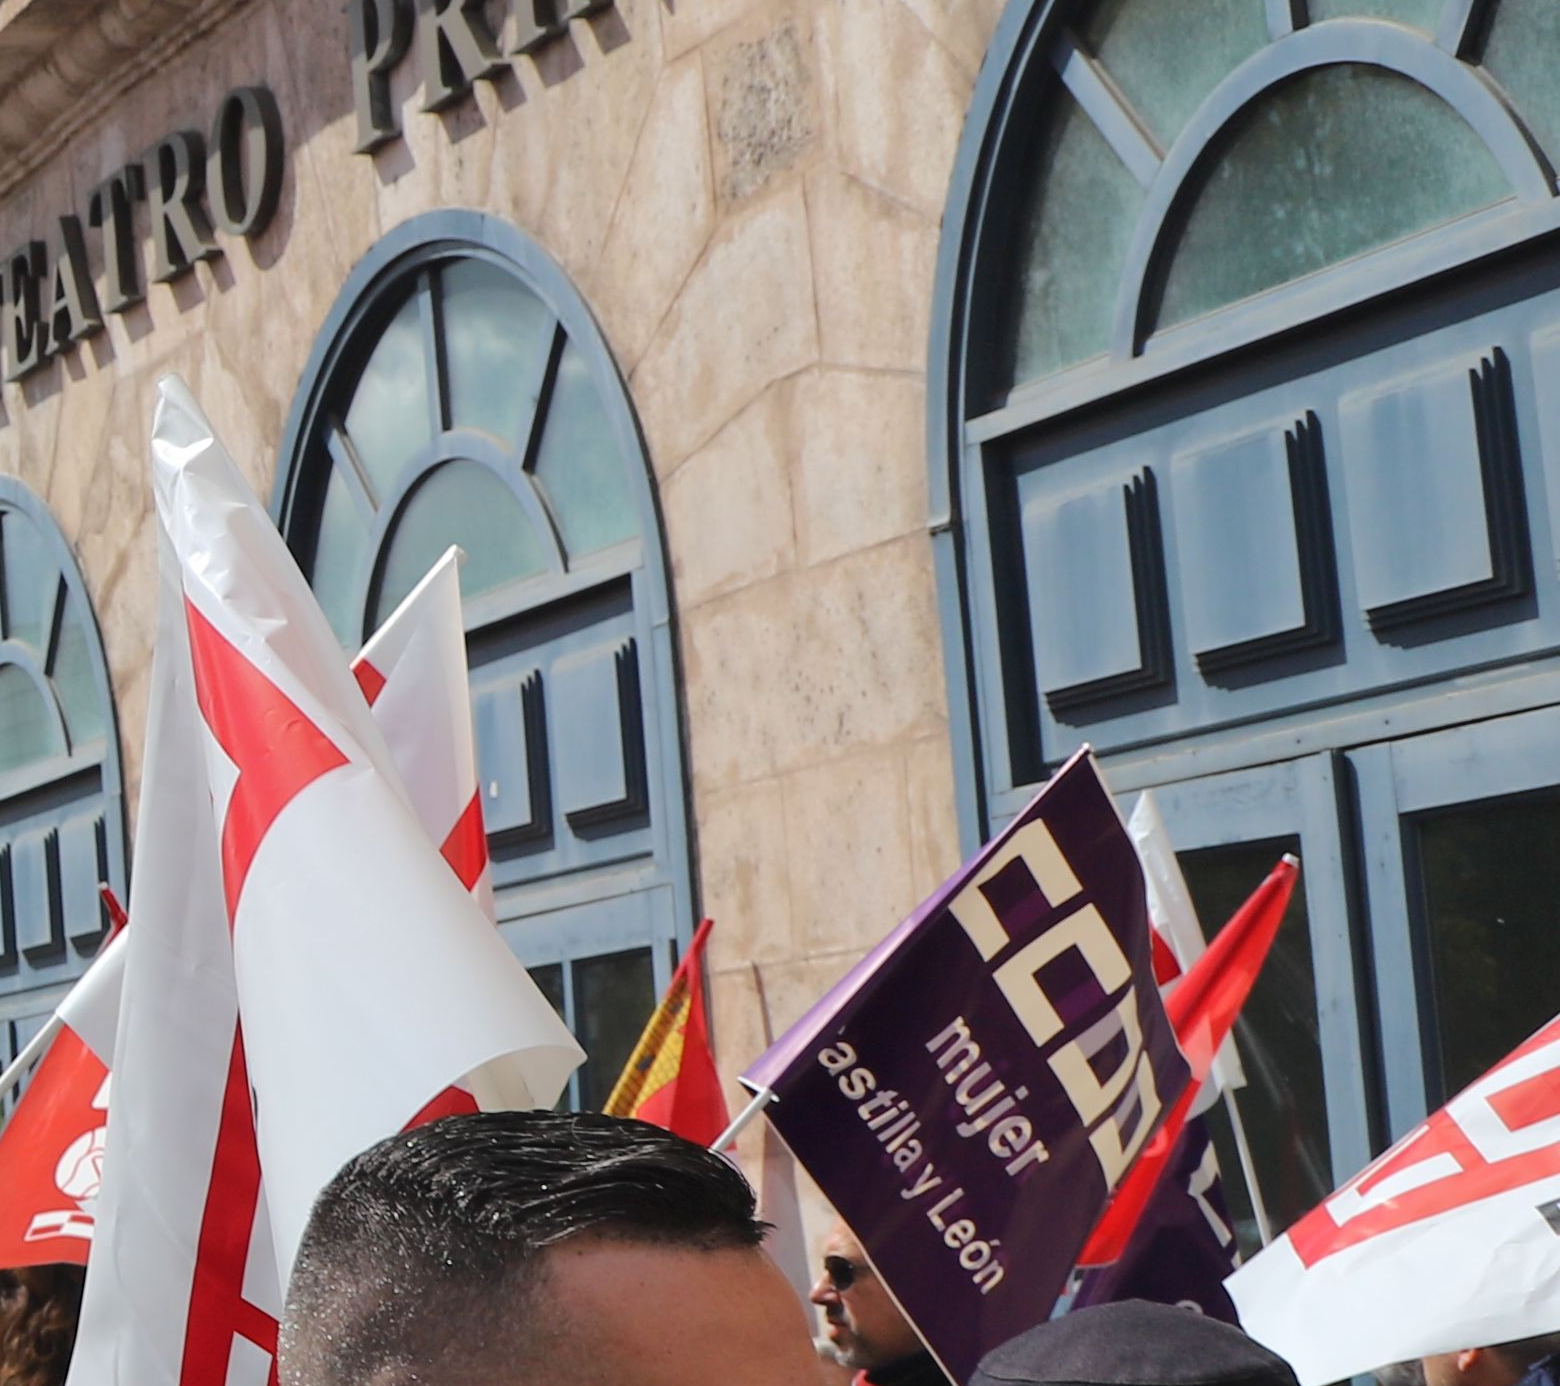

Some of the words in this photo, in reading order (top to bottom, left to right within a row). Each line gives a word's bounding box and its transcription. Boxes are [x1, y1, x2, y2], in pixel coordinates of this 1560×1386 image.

[817, 1025, 922, 1174] astilla
[901, 1163, 942, 1200] y
[926, 1187, 1004, 1295] León
[925, 1015, 1049, 1176] mujer
